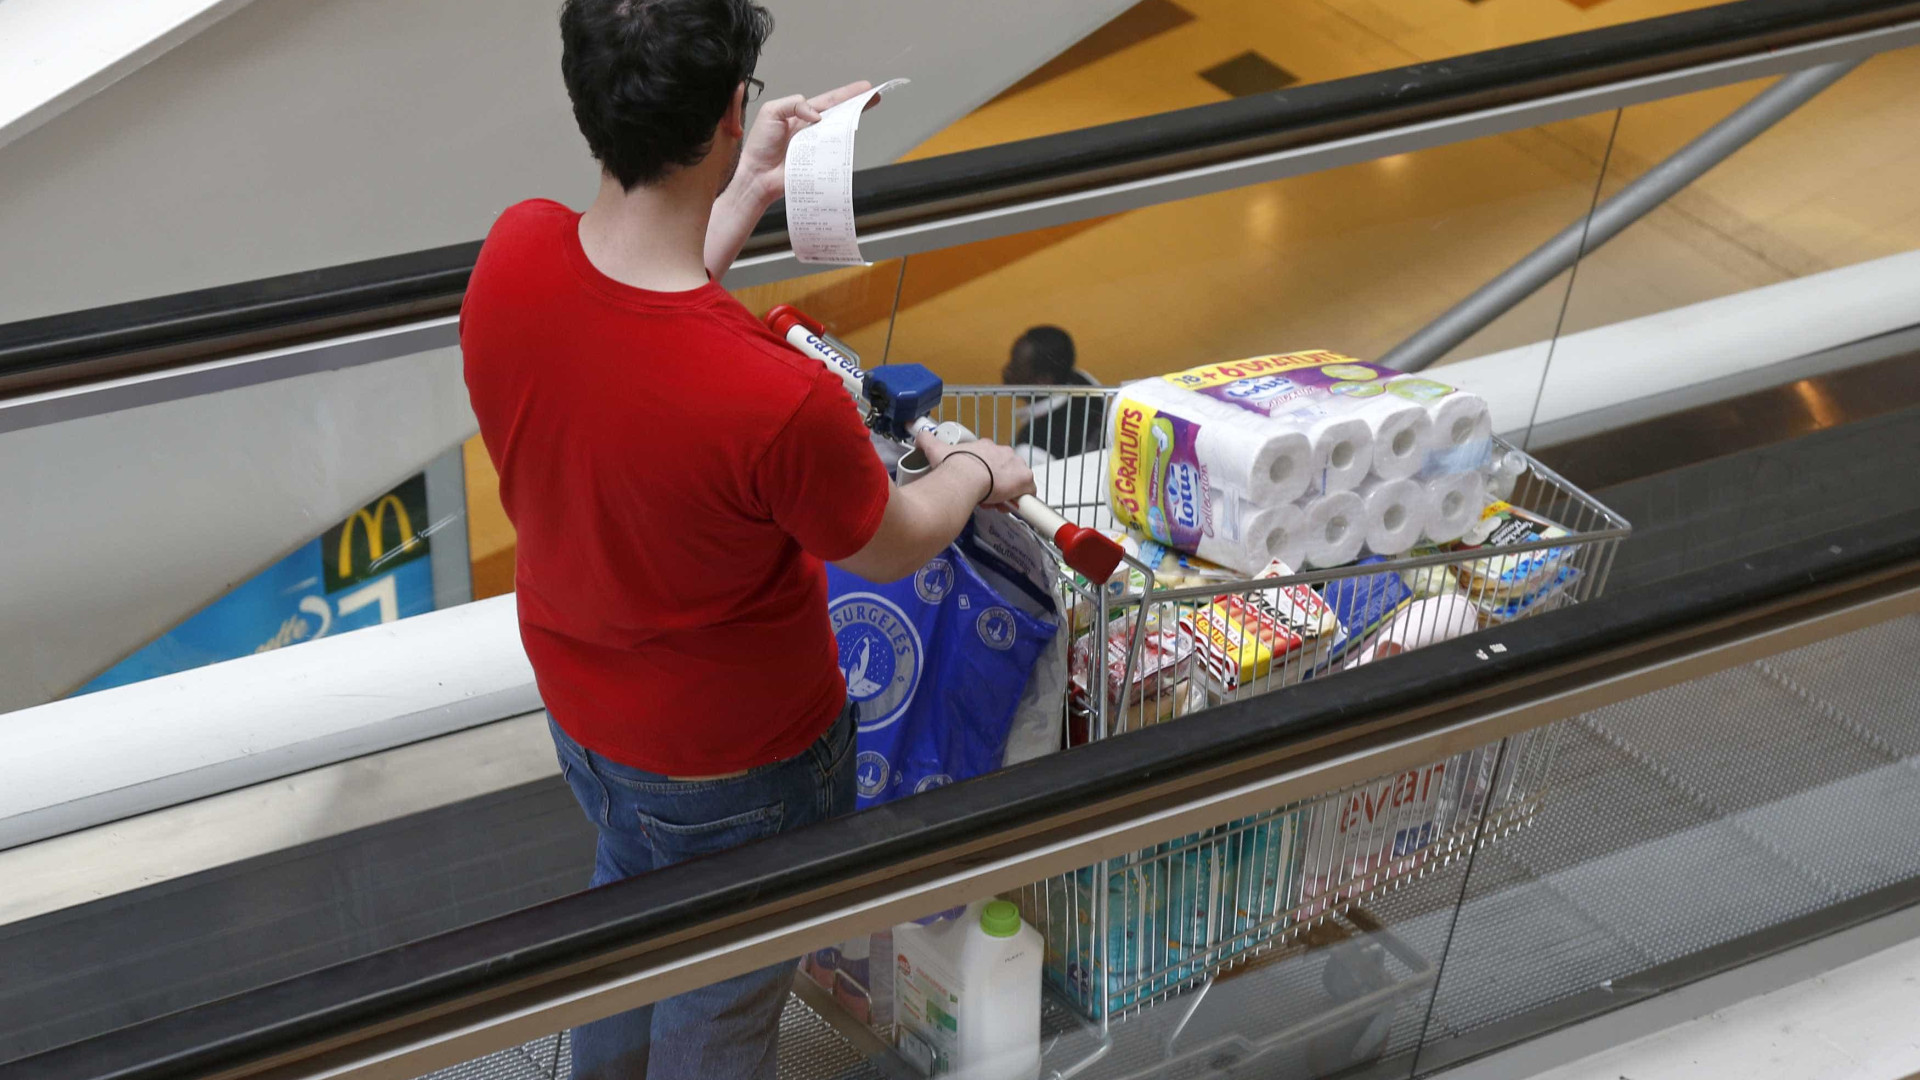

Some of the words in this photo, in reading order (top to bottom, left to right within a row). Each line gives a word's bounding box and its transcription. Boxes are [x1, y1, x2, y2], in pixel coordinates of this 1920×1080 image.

[1218, 365, 1247, 379] 6
[1114, 407, 1144, 495] GRATUITS
[1178, 463, 1195, 528] lotus
[1199, 462, 1215, 538] Collection
[1340, 763, 1445, 834] evan
